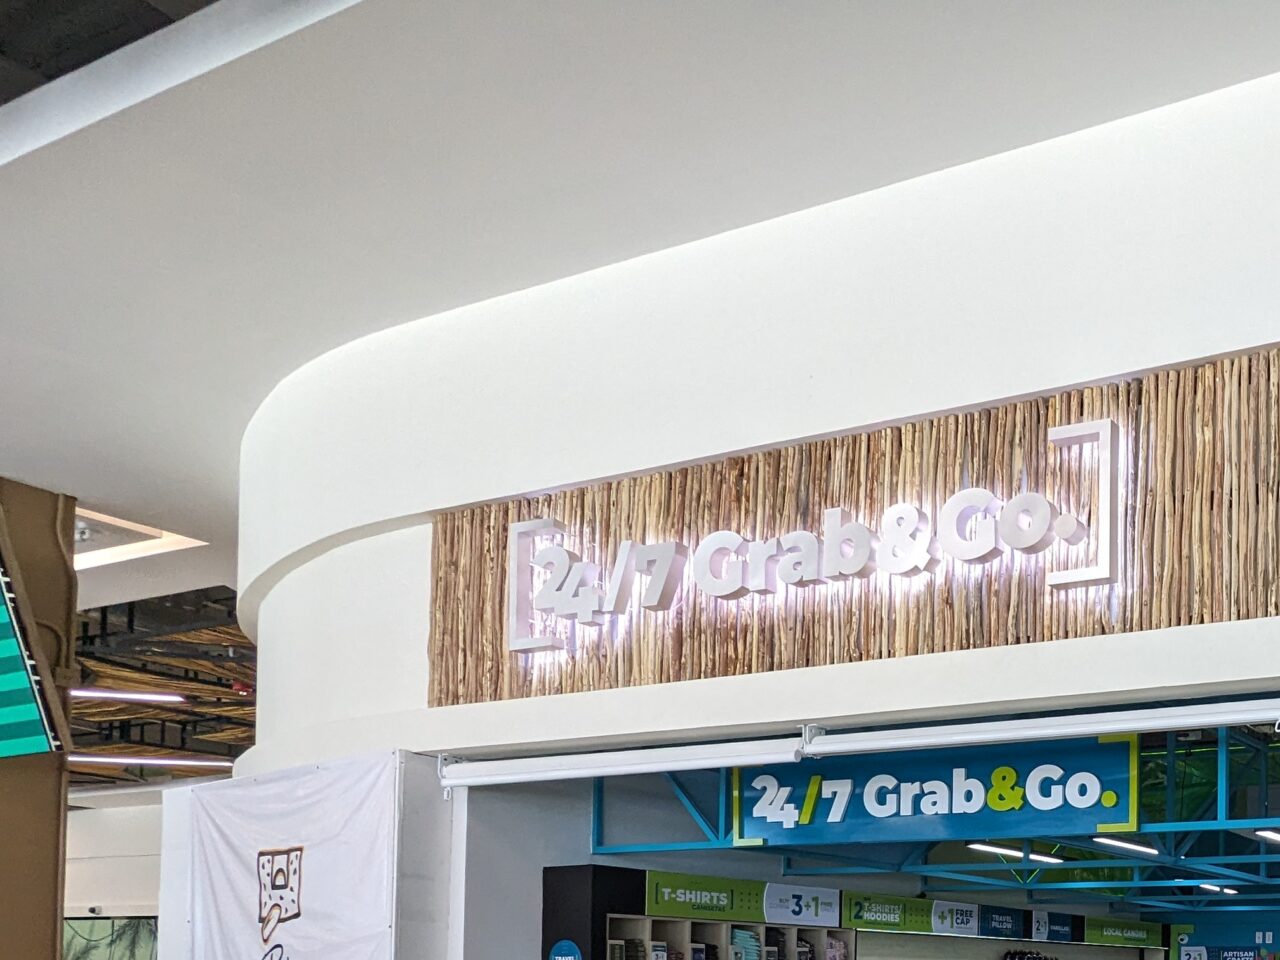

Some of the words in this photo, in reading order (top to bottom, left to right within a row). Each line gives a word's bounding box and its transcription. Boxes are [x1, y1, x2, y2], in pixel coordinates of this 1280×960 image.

[532, 538, 688, 627] 24/7
[695, 487, 1089, 600] Grab&Go.
[751, 774, 853, 829] 24/7
[863, 763, 1118, 817] Grab&Go.
[662, 888, 728, 905] T-SHIRTS
[853, 901, 863, 920] 2
[955, 908, 973, 918] FREE
[863, 911, 900, 922] HOODIES
[955, 917, 971, 926] CAP
[992, 914, 1012, 922] TRAVEL
[991, 921, 1012, 929] PILLOW
[1103, 927, 1122, 936] LOCAL
